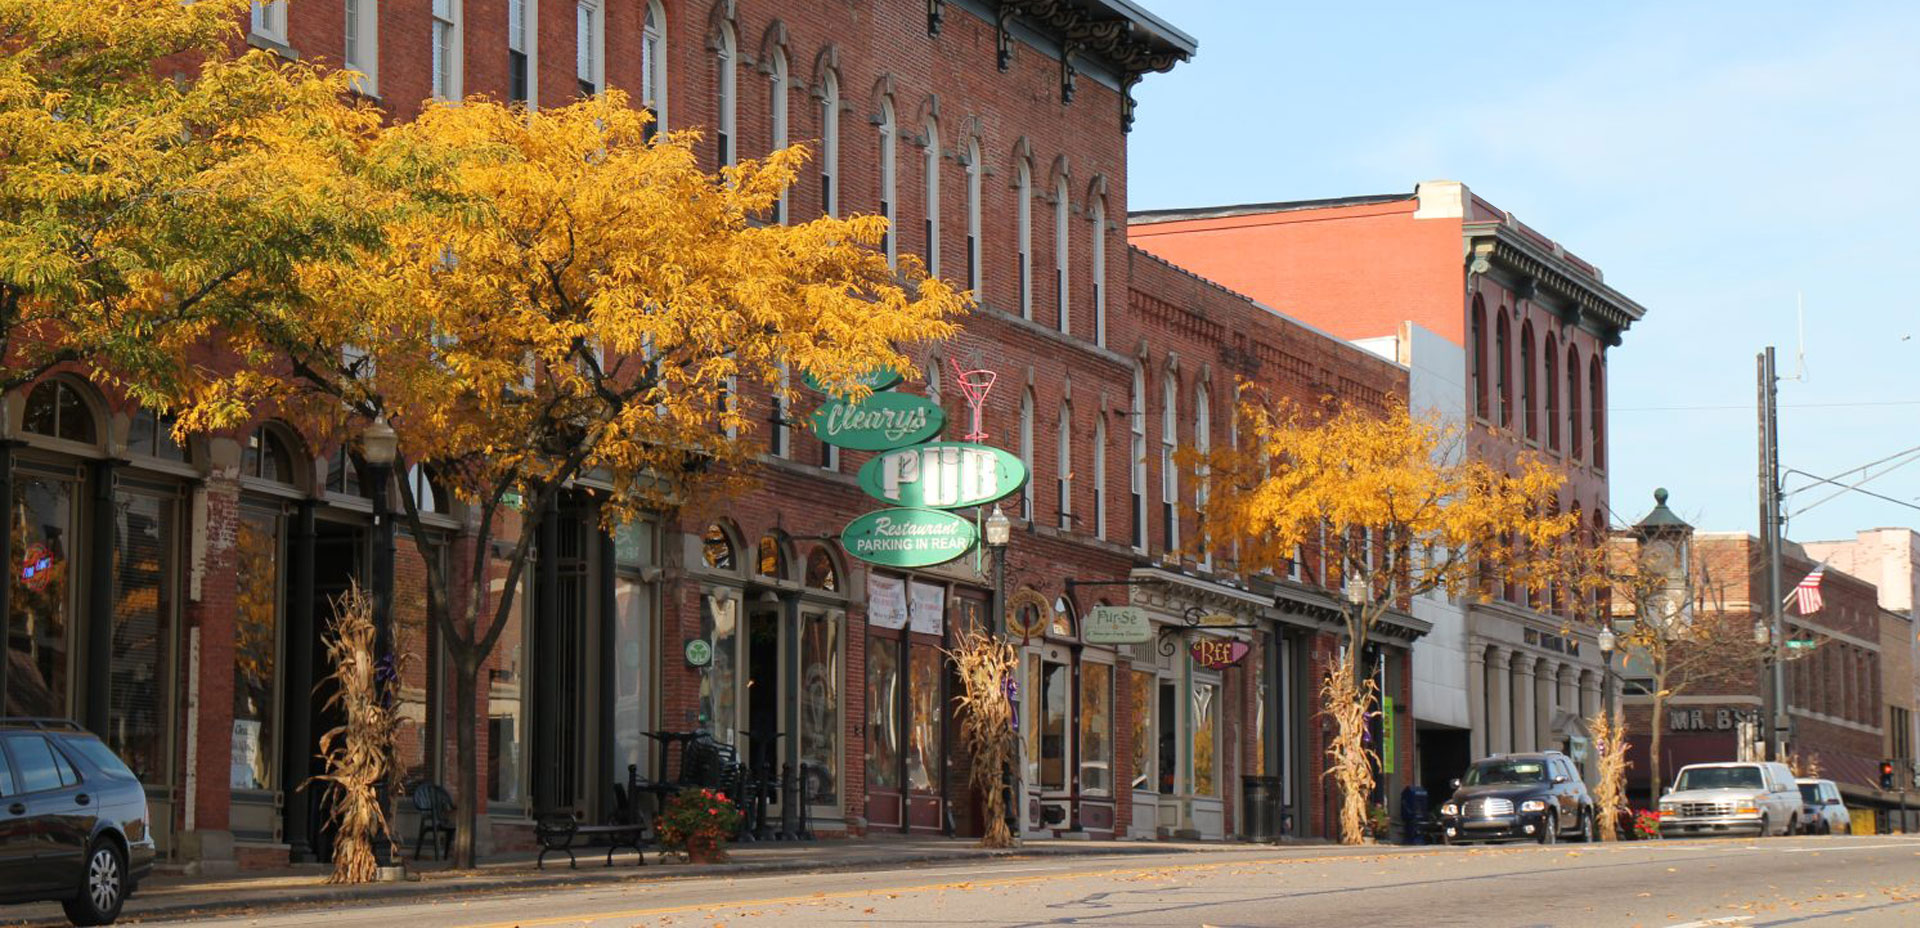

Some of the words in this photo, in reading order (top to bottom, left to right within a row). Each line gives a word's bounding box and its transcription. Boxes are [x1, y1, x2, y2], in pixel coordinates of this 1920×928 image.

[883, 446, 998, 506] PUB
[875, 516, 959, 536] Restaurant
[857, 538, 913, 551] PARKING
[915, 537, 929, 550] IN
[932, 537, 967, 550] REAR
[1670, 709, 1713, 730] MR.
